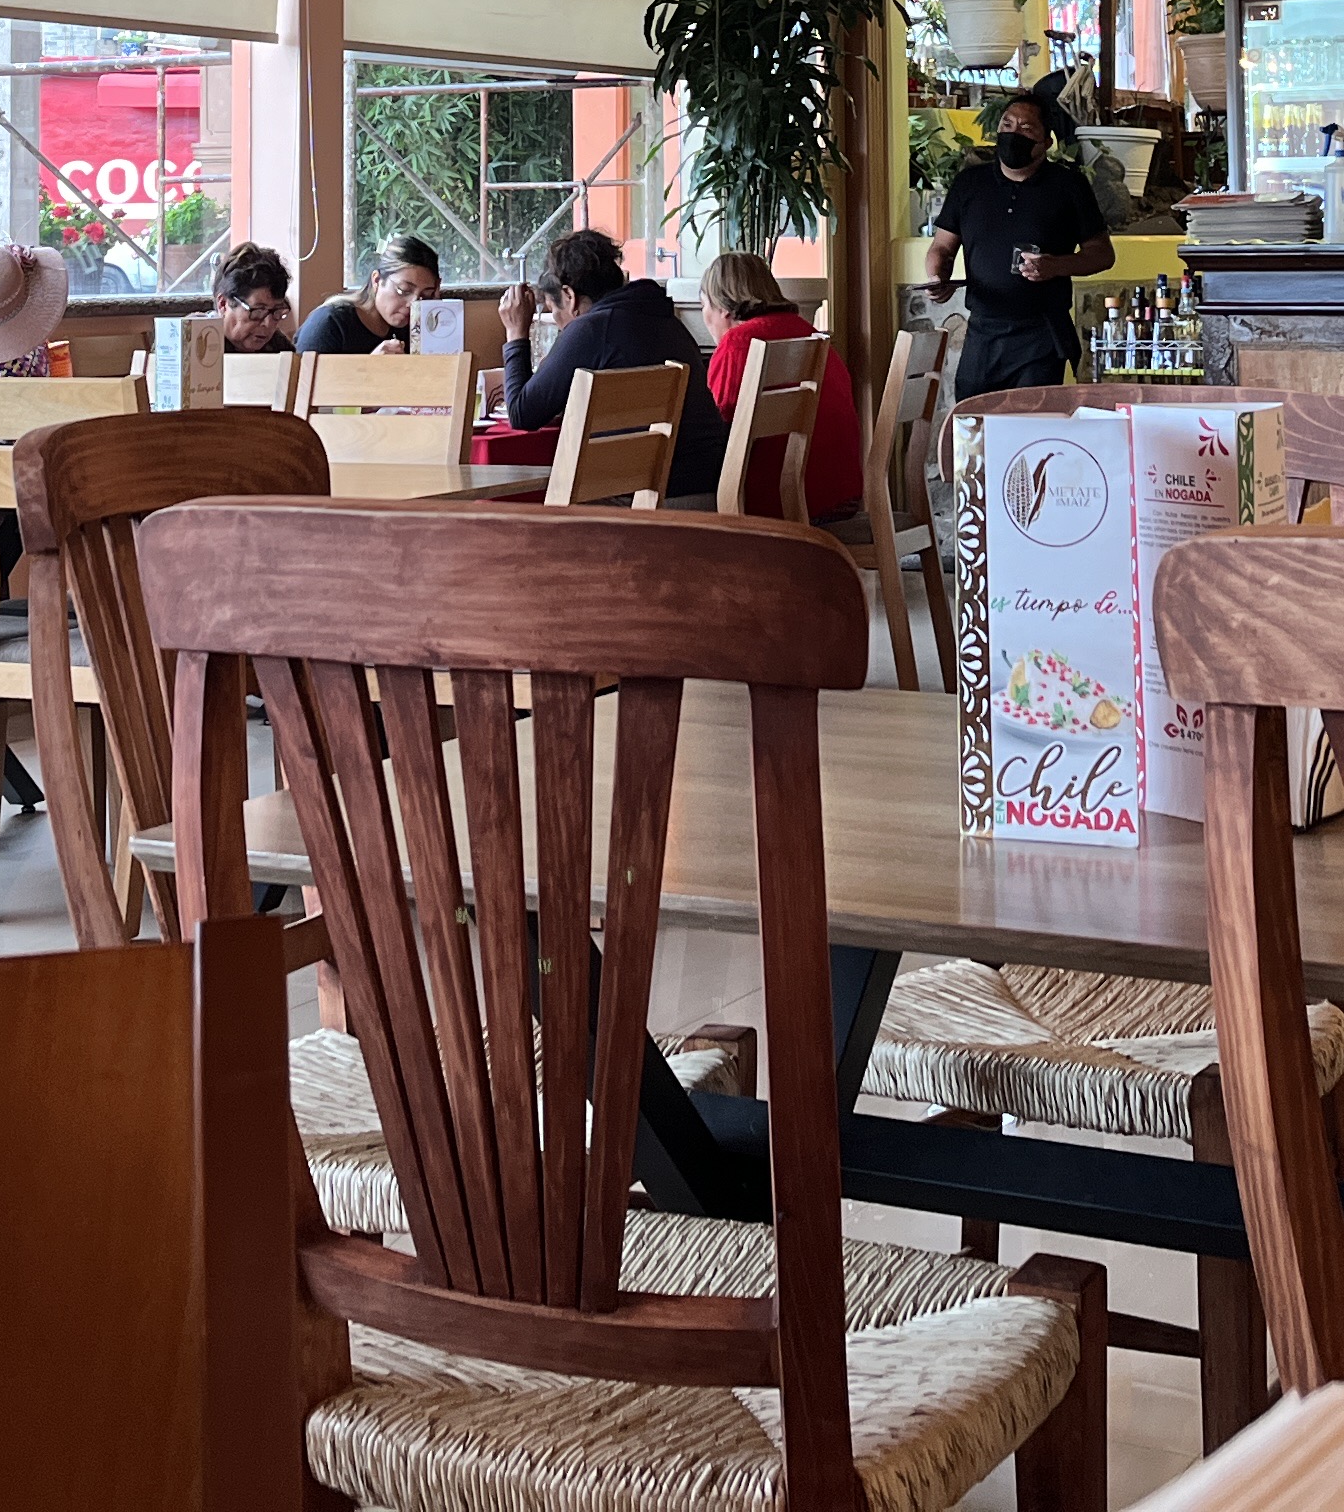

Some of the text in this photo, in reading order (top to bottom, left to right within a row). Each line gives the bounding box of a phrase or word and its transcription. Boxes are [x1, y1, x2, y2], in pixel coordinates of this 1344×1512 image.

[1048, 486, 1102, 498] METATE
[1165, 473, 1196, 487] CHILE
[1155, 488, 1213, 503] EN NOGADA
[990, 596, 1011, 613] es
[1014, 588, 1088, 621] tiempo
[996, 744, 1133, 813] Chile
[995, 799, 1137, 834] EN NOGADA
